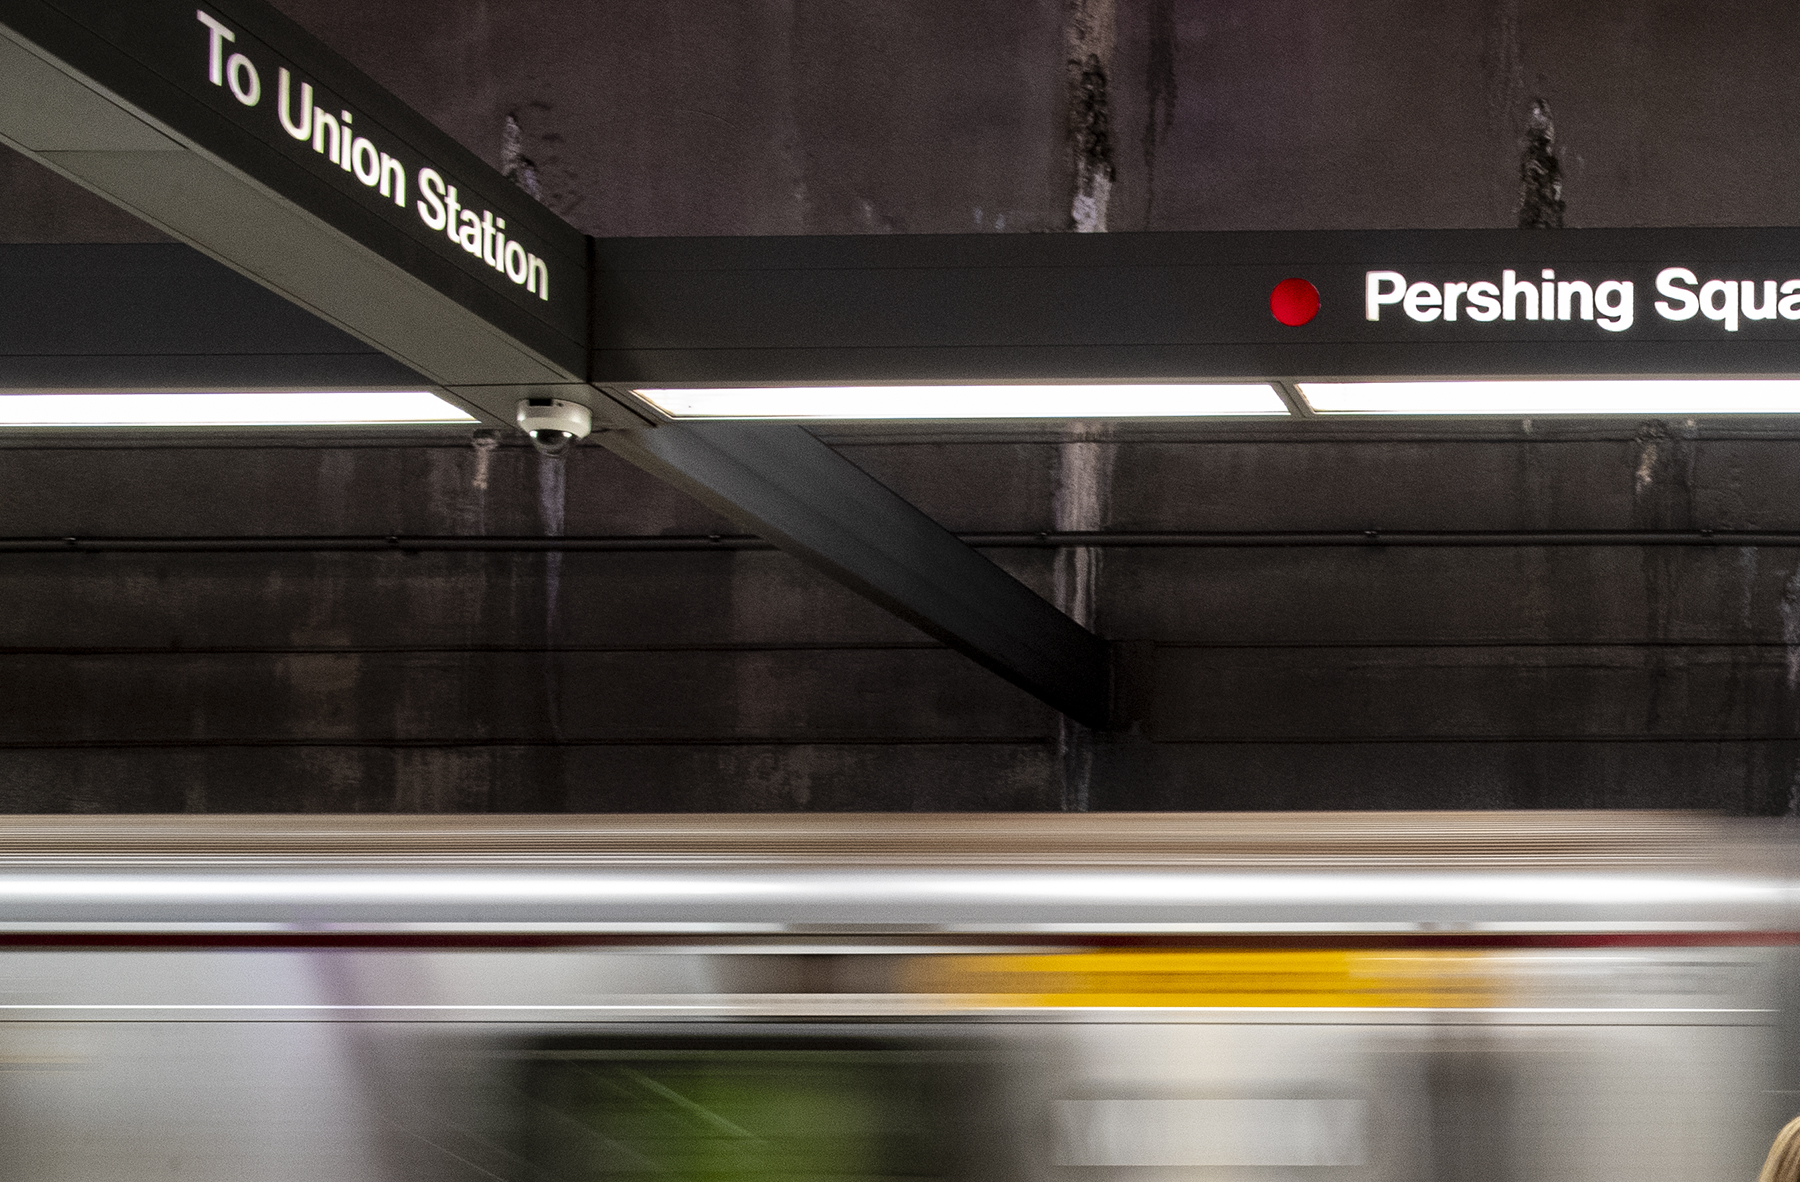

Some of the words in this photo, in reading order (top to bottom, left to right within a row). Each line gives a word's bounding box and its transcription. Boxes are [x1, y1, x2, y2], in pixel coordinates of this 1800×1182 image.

[197, 9, 261, 106] To
[278, 66, 406, 208] Union
[416, 167, 548, 301] Station
[1365, 269, 1635, 332] Pershing
